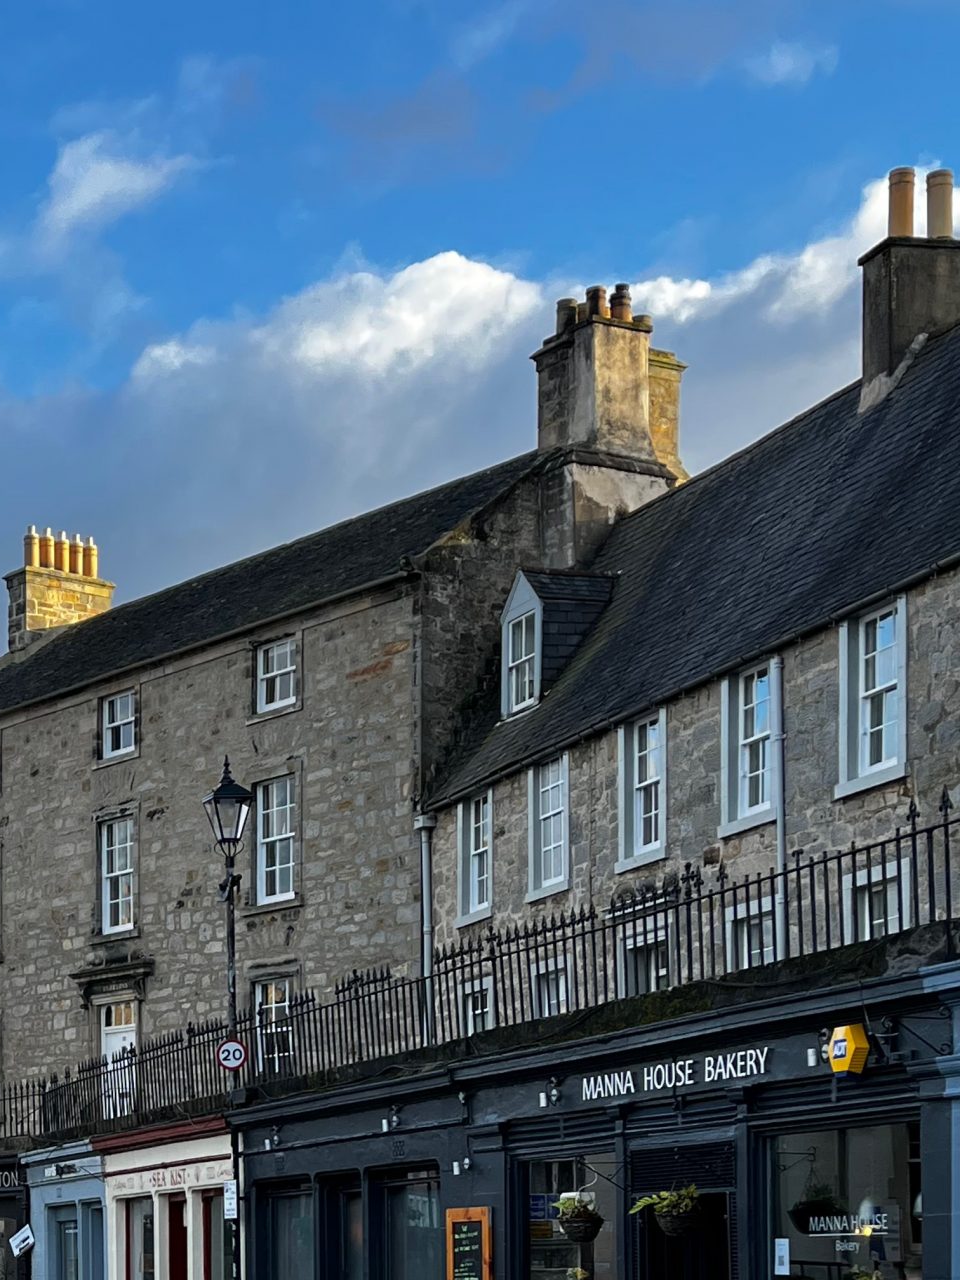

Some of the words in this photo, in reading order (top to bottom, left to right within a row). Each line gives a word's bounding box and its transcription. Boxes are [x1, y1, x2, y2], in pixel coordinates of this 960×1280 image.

[222, 1048, 243, 1061] 20
[582, 1070, 635, 1101] MANNA
[643, 1059, 695, 1092] HOUSE
[704, 1047, 769, 1083] BAKERY
[152, 1172, 167, 1188] SEA
[170, 1168, 187, 1186] KIST
[809, 1215, 849, 1232] MANNA
[850, 1213, 888, 1231] HOUSE
[835, 1240, 860, 1253] Bakery
